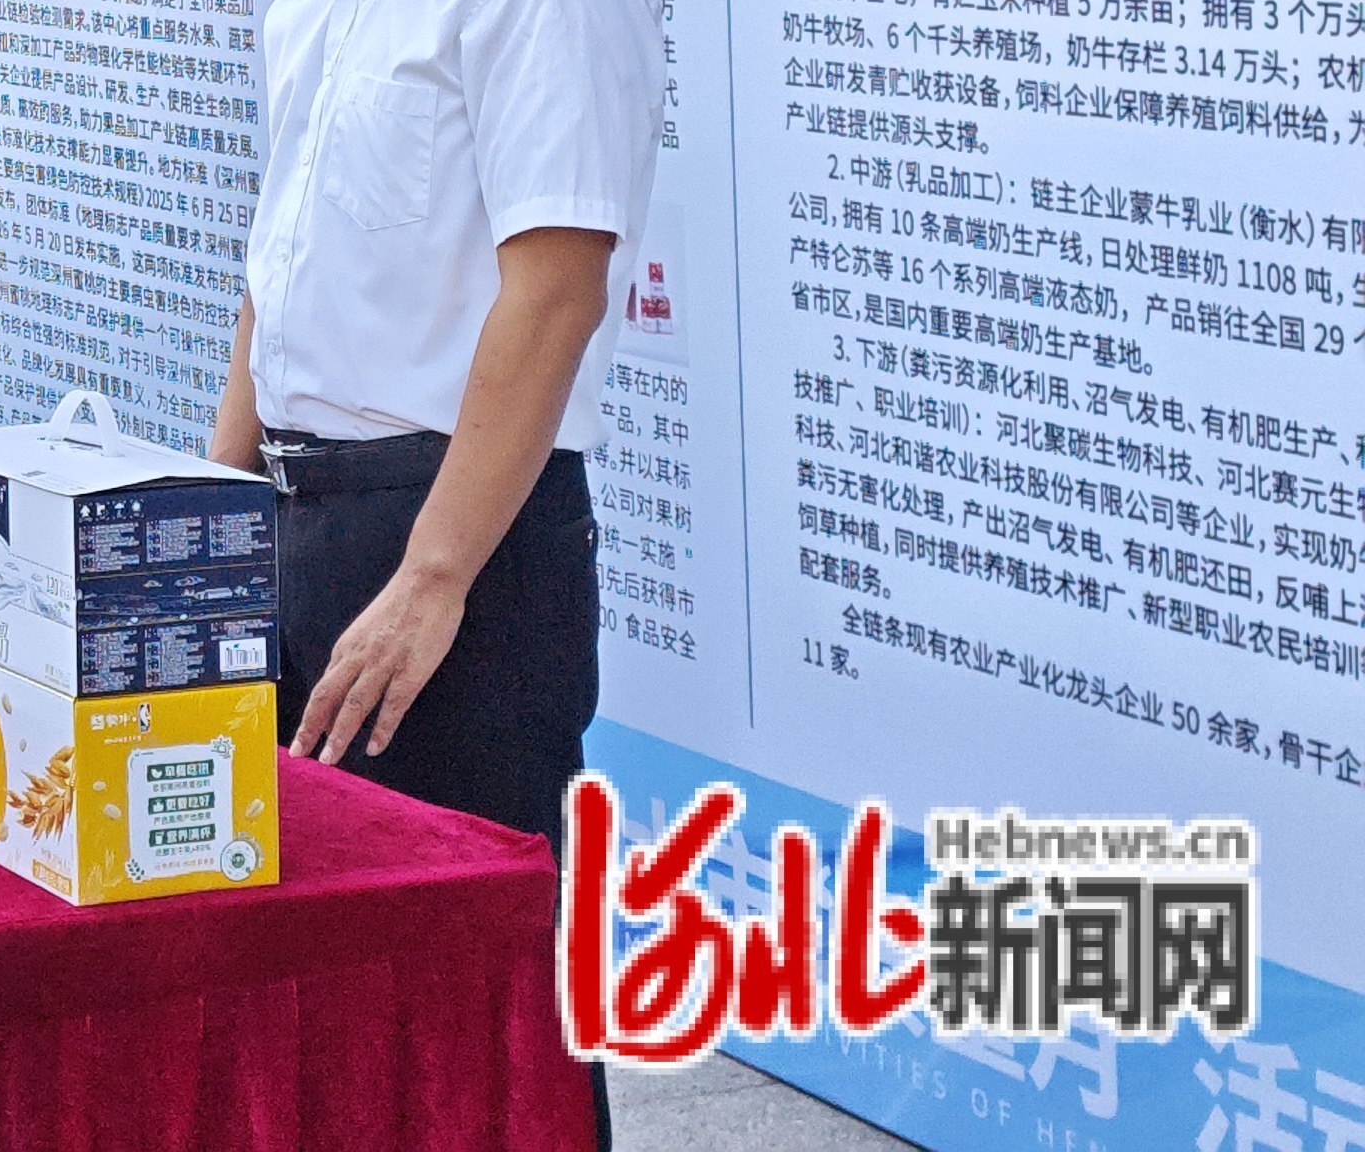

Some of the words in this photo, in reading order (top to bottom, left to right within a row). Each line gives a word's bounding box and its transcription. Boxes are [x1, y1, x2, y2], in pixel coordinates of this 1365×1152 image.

[785, 101, 989, 155] 产业链提供源头支撑。
[795, 412, 1365, 573] 科技、河北和谐农业科技股份有限公司等企业，实现奶
[797, 457, 1365, 627] 粪污无害化处理，产出沼气发电、有机肥还田，反哺上
[798, 500, 1365, 680] 饲草种植，同时提供养殖技术推广、新型职业农民培训
[799, 546, 893, 603] 配套服务。
[970, 1085, 1012, 1127] OF
